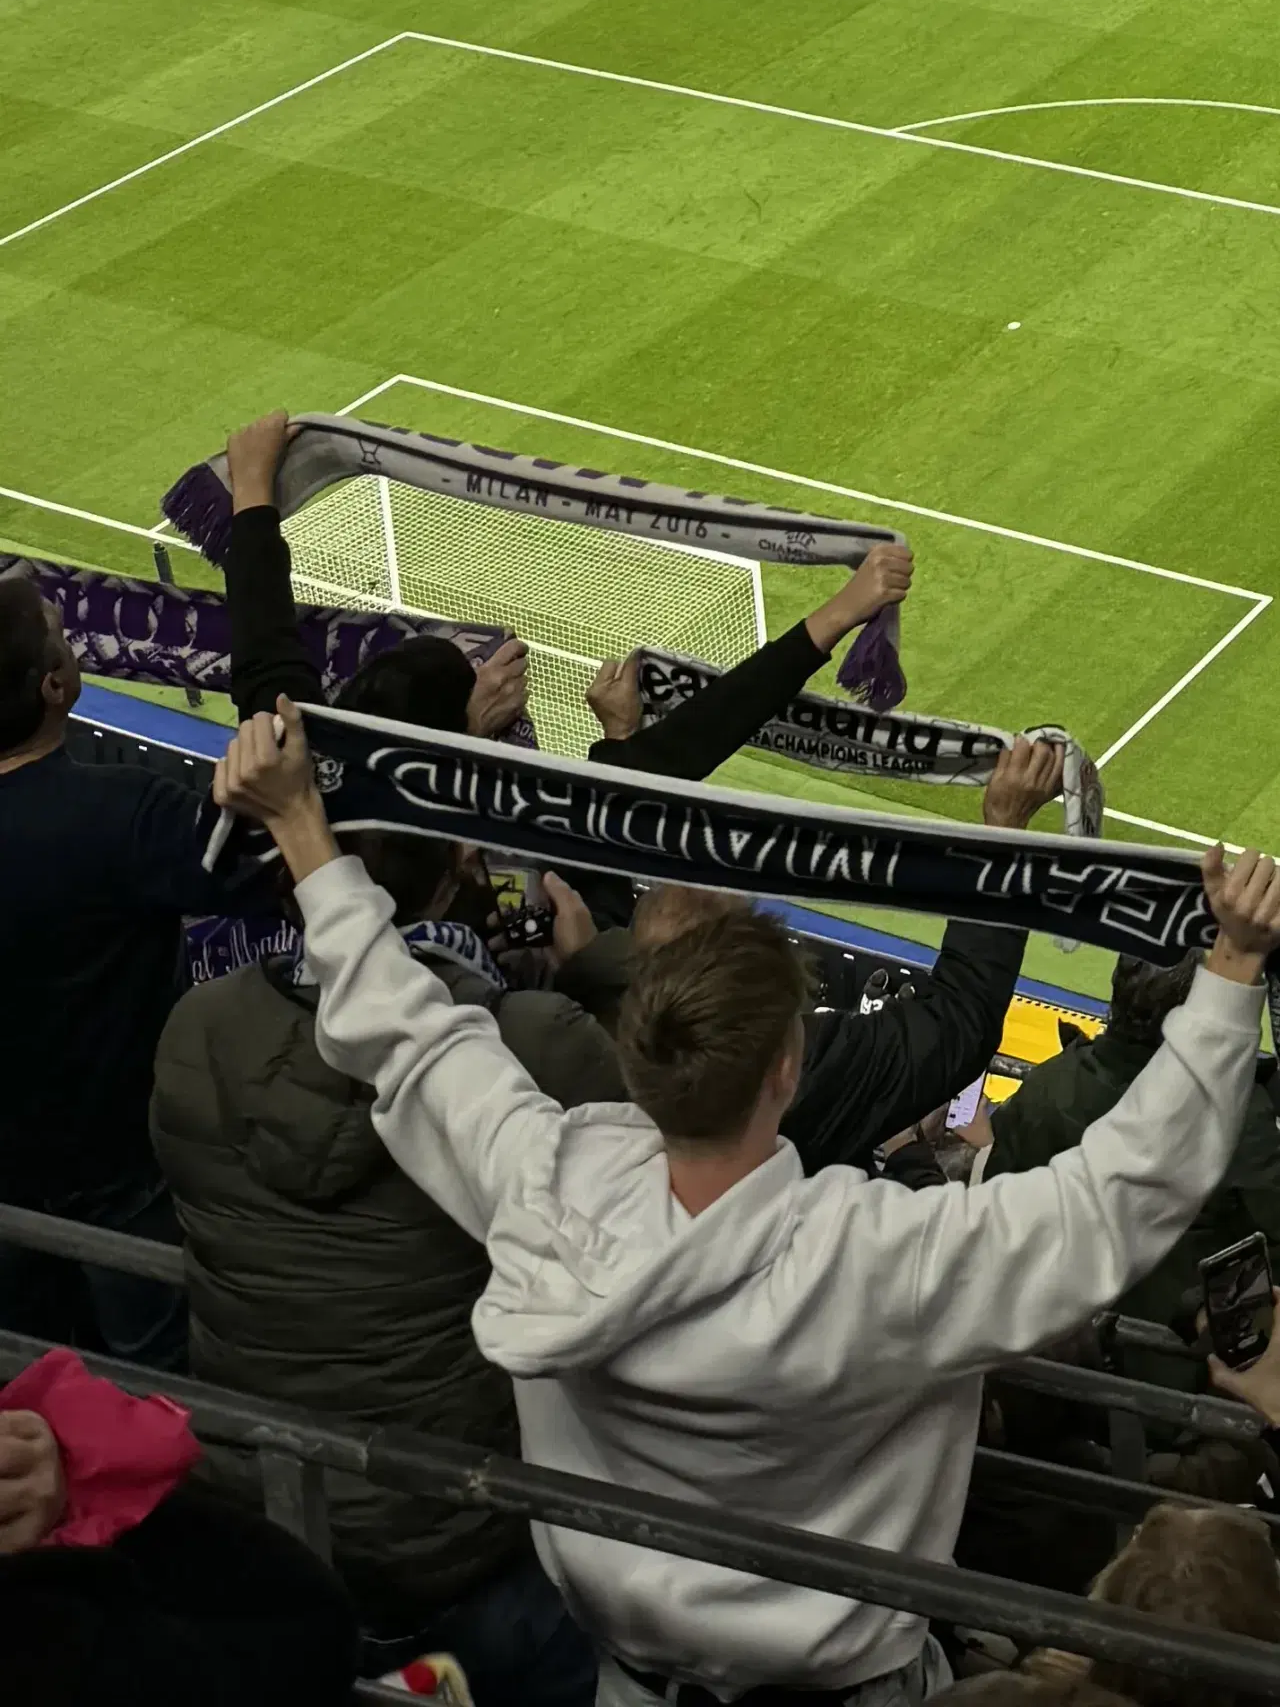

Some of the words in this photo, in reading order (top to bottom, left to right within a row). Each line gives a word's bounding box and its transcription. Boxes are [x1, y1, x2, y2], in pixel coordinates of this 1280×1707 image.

[466, 473, 548, 508] MILAN
[650, 511, 708, 539] 2016
[773, 699, 940, 757] adrid
[774, 733, 867, 766] CHAMPIONS
[872, 752, 935, 773] LEAGUE
[226, 918, 302, 972] Madr
